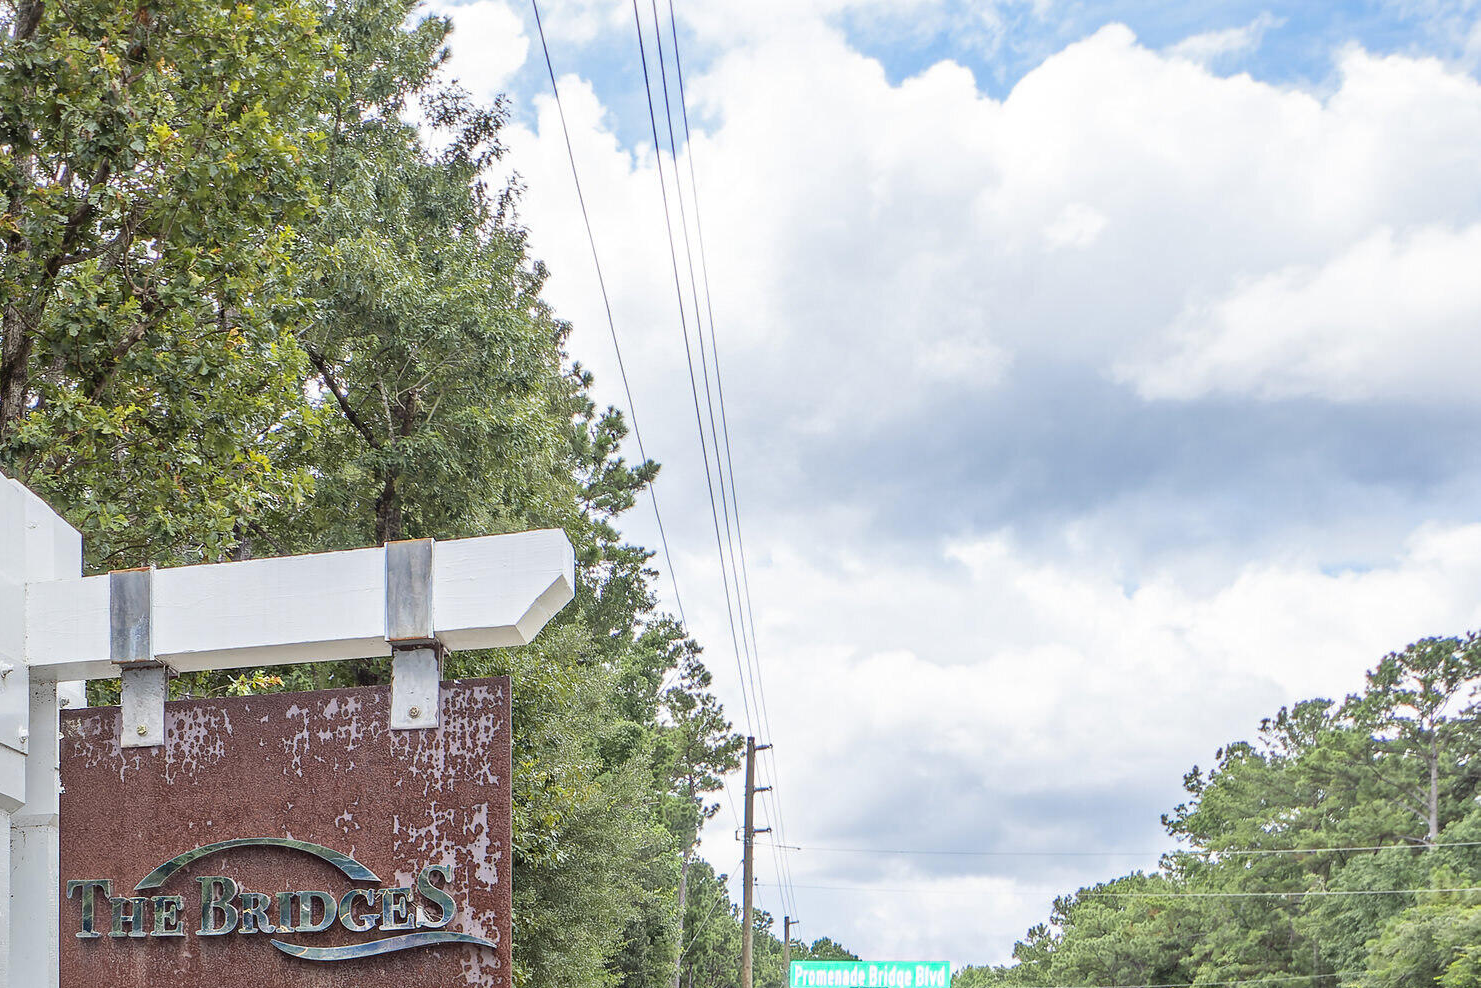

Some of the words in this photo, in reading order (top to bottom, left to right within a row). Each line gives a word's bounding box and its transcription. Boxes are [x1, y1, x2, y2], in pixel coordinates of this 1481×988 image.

[794, 965, 866, 987] Promenade
[869, 964, 912, 988] Bridge
[915, 965, 945, 987] Blvd
